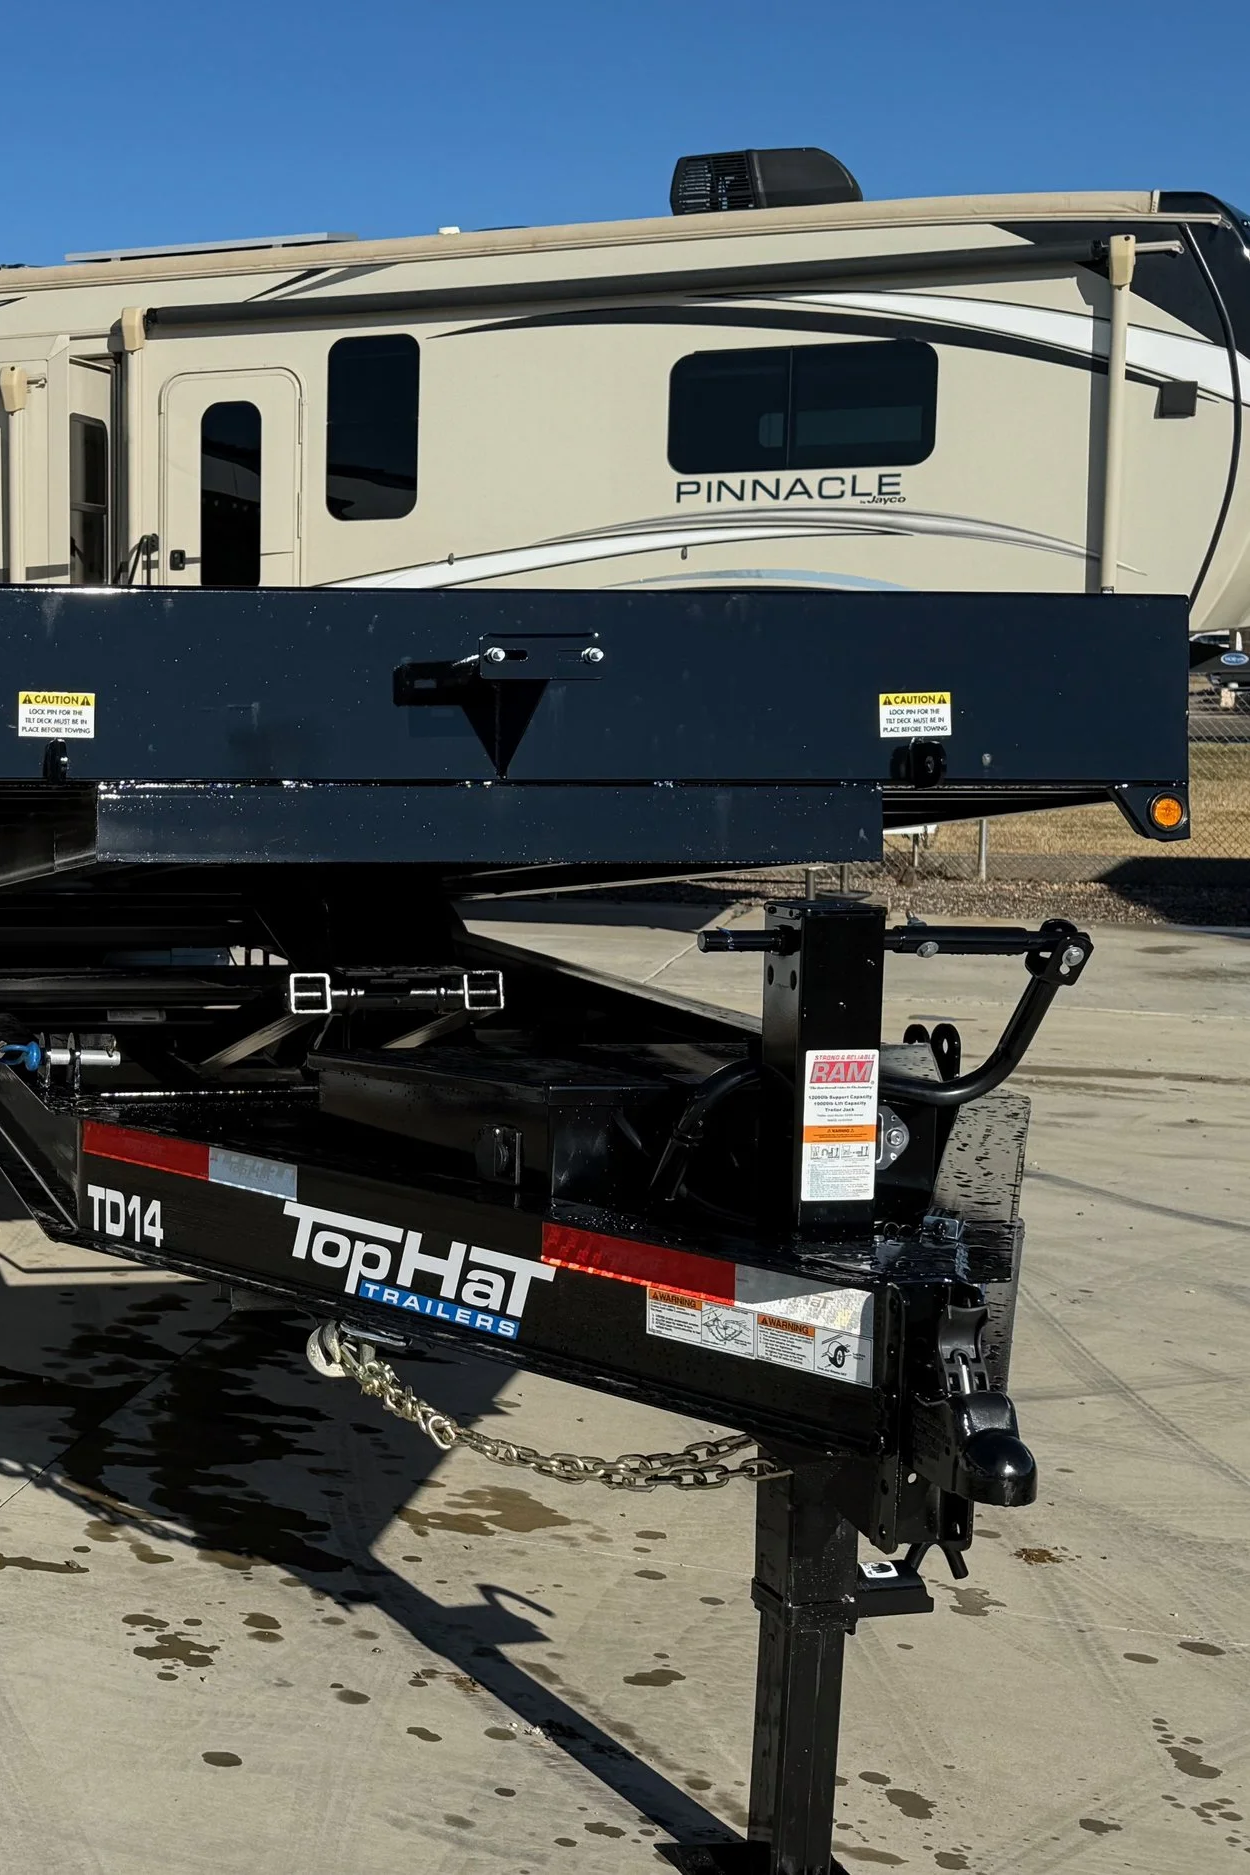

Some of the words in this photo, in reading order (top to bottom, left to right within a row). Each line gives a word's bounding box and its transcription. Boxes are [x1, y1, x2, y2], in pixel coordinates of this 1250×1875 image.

[675, 473, 902, 503] PINNACLE
[867, 496, 907, 505] Jayco
[34, 695, 79, 705] CAUTION
[893, 695, 936, 705] CAUTION
[811, 1062, 872, 1082] RAM
[88, 1183, 164, 1248] TD14
[659, 1291, 697, 1309] WARNING
[365, 1282, 518, 1338] TRAILERS
[768, 1317, 809, 1335] WARNING
